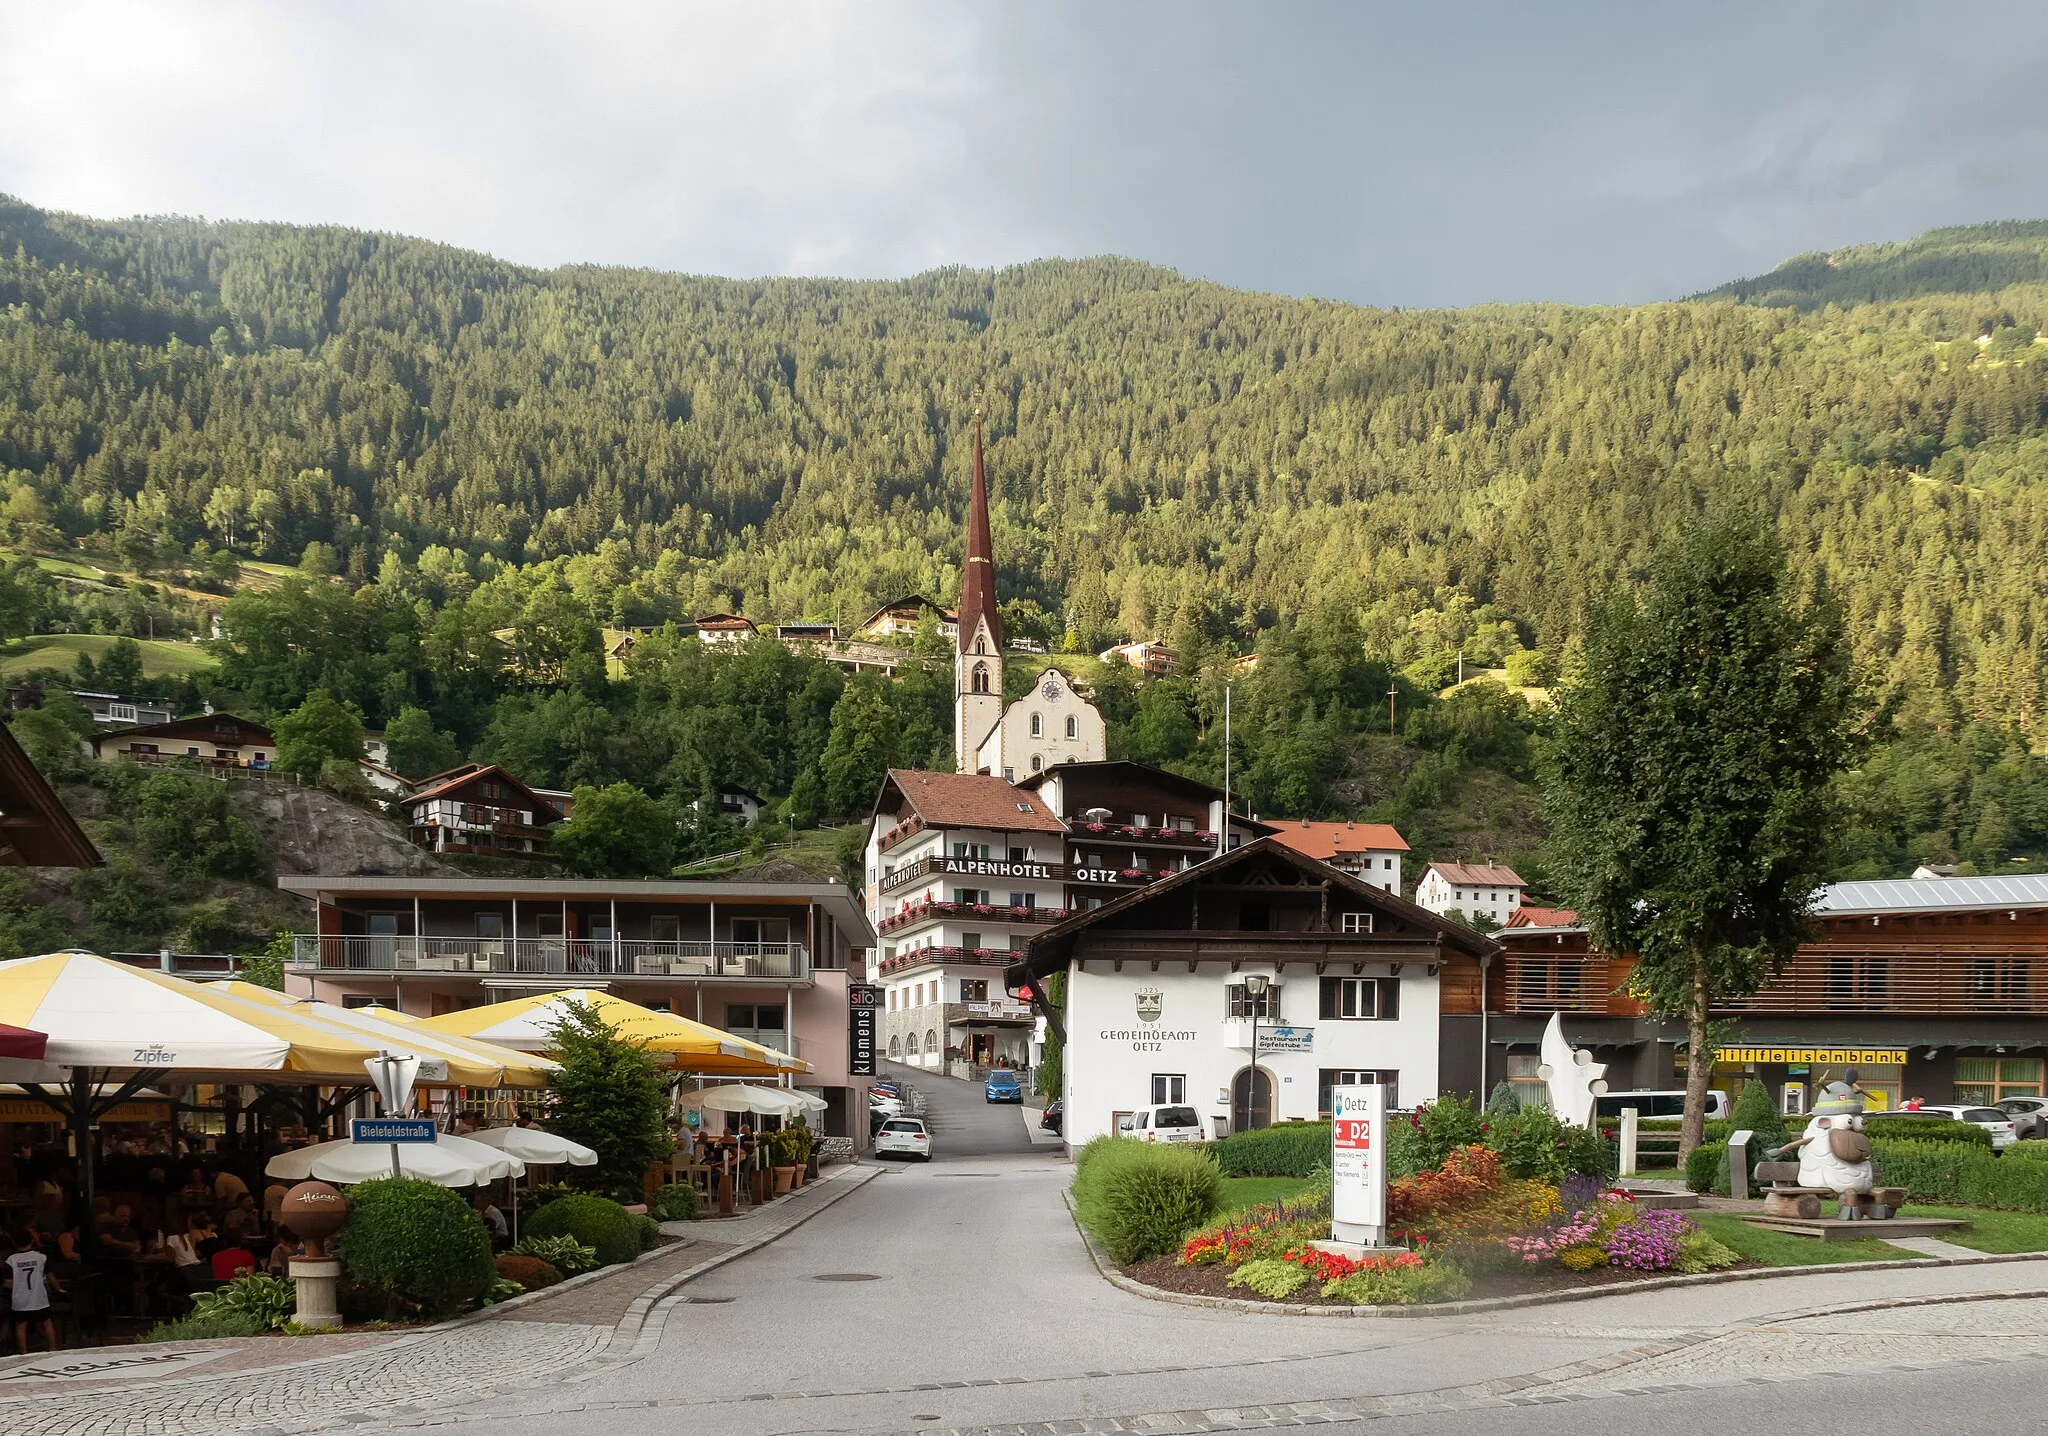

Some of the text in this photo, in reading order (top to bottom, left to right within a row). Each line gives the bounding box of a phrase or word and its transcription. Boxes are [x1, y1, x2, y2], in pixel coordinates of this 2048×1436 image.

[883, 862, 921, 890] ALPENHOTEL
[946, 860, 1117, 883] ALPENHOTEL OETZ
[854, 1011, 870, 1073] klemens
[1100, 1029, 1197, 1041] GEMEINDEAMT
[1133, 1042, 1162, 1052] OETZ
[133, 1049, 177, 1064] Zipfer
[1344, 1096, 1367, 1111] Oetz
[360, 1125, 429, 1137] Bielefeldstraße
[1350, 1122, 1369, 1140] D2
[296, 1191, 341, 1203] Heiner
[22, 1267, 35, 1290] 7
